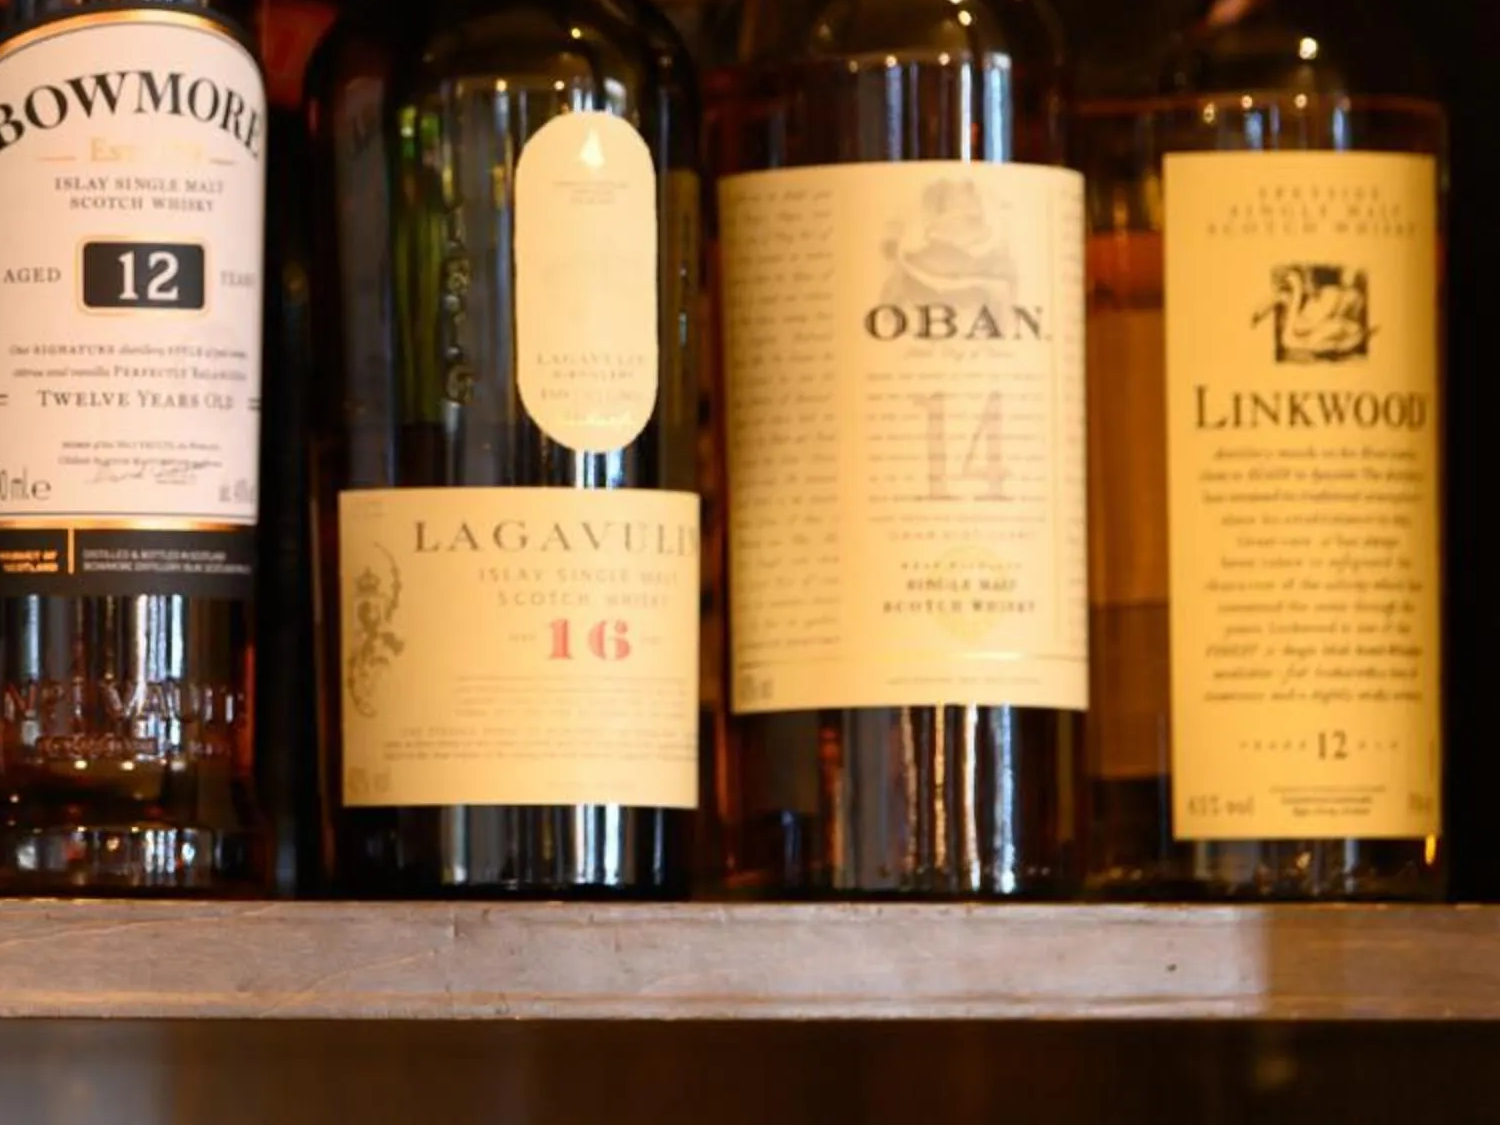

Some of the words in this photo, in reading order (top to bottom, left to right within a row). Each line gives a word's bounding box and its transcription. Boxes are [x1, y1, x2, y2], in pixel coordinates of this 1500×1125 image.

[54, 177, 107, 192] ISLAY
[115, 178, 179, 193] SINGLE
[185, 179, 225, 195] MALT
[69, 195, 144, 210] SCOTCH
[151, 196, 215, 212] WHISKY
[3, 267, 62, 285] AGED
[118, 250, 180, 301] 12
[33, 344, 116, 356] SIGNATURE
[37, 389, 130, 408] TWELVE
[136, 389, 200, 409] YEARS
[203, 390, 235, 411] OLD
[1194, 384, 1428, 430] LINKWOOD
[912, 390, 1018, 502] 14
[478, 568, 543, 583] ISLAY
[557, 568, 630, 584] SINGLE
[497, 591, 591, 607] SCOTCH
[547, 617, 633, 662] 16
[1317, 730, 1348, 761] 12
